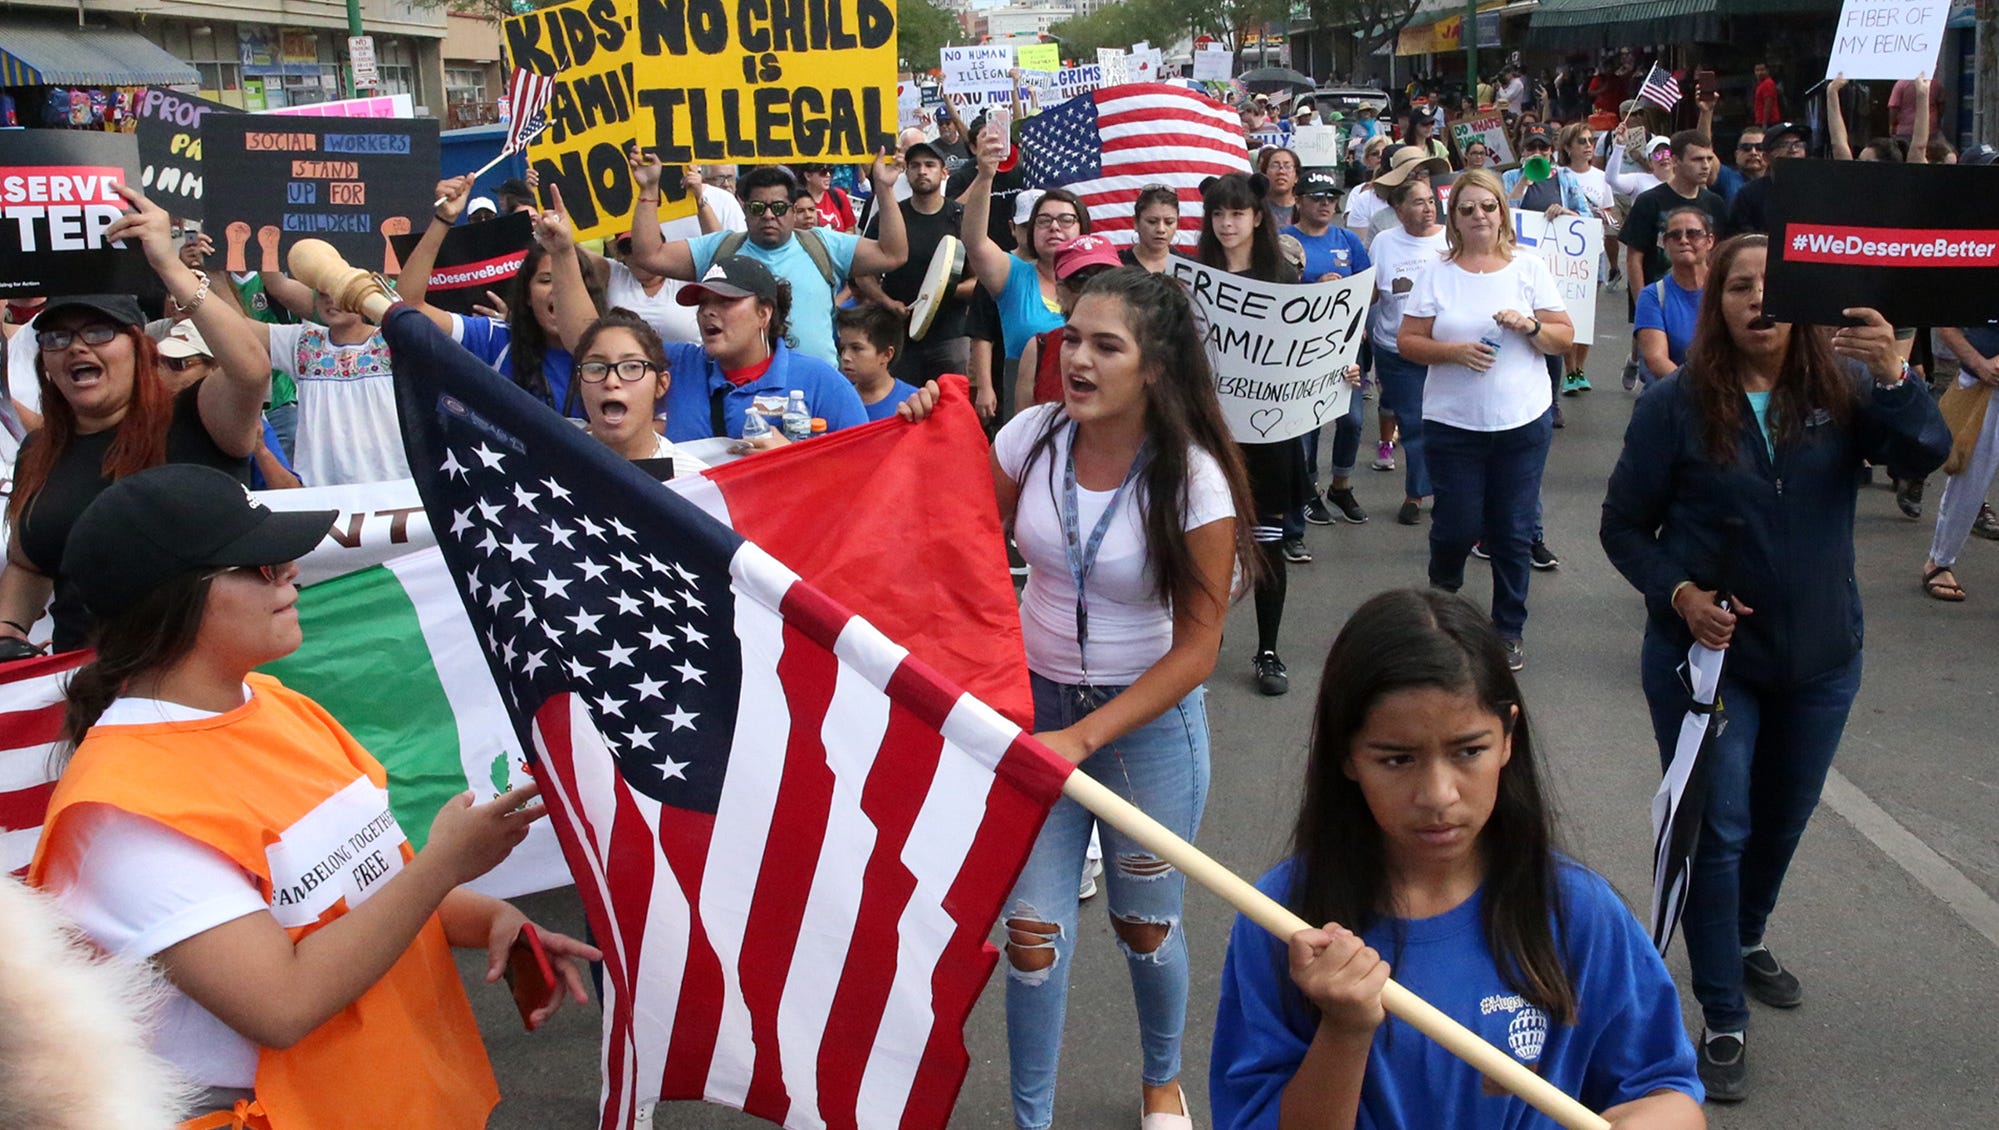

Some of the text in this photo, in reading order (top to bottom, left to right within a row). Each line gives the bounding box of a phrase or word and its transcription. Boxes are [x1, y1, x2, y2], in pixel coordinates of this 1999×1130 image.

[639, 0, 894, 55] NO CHILD
[1846, 7, 1934, 27] FIBER OF
[945, 49, 1006, 61] NO HUMAN
[1838, 33, 1928, 55] MY BEING
[743, 53, 782, 84] IS
[958, 69, 1009, 82] ILLEGAL
[971, 61, 985, 70] IS
[638, 87, 896, 162] ILLEGAL
[250, 133, 406, 150] SOCIAL WORKERS
[295, 161, 354, 177] STAND
[0, 175, 119, 202] SERVE
[289, 185, 362, 203] UP FOR
[0, 204, 128, 252] TER
[286, 214, 368, 232] CHILDREN
[1515, 213, 1586, 257] LAS
[1792, 233, 1996, 258] #WeDeserveBetter
[1173, 263, 1352, 325] FREE OUR
[352, 849, 390, 892] FREE
